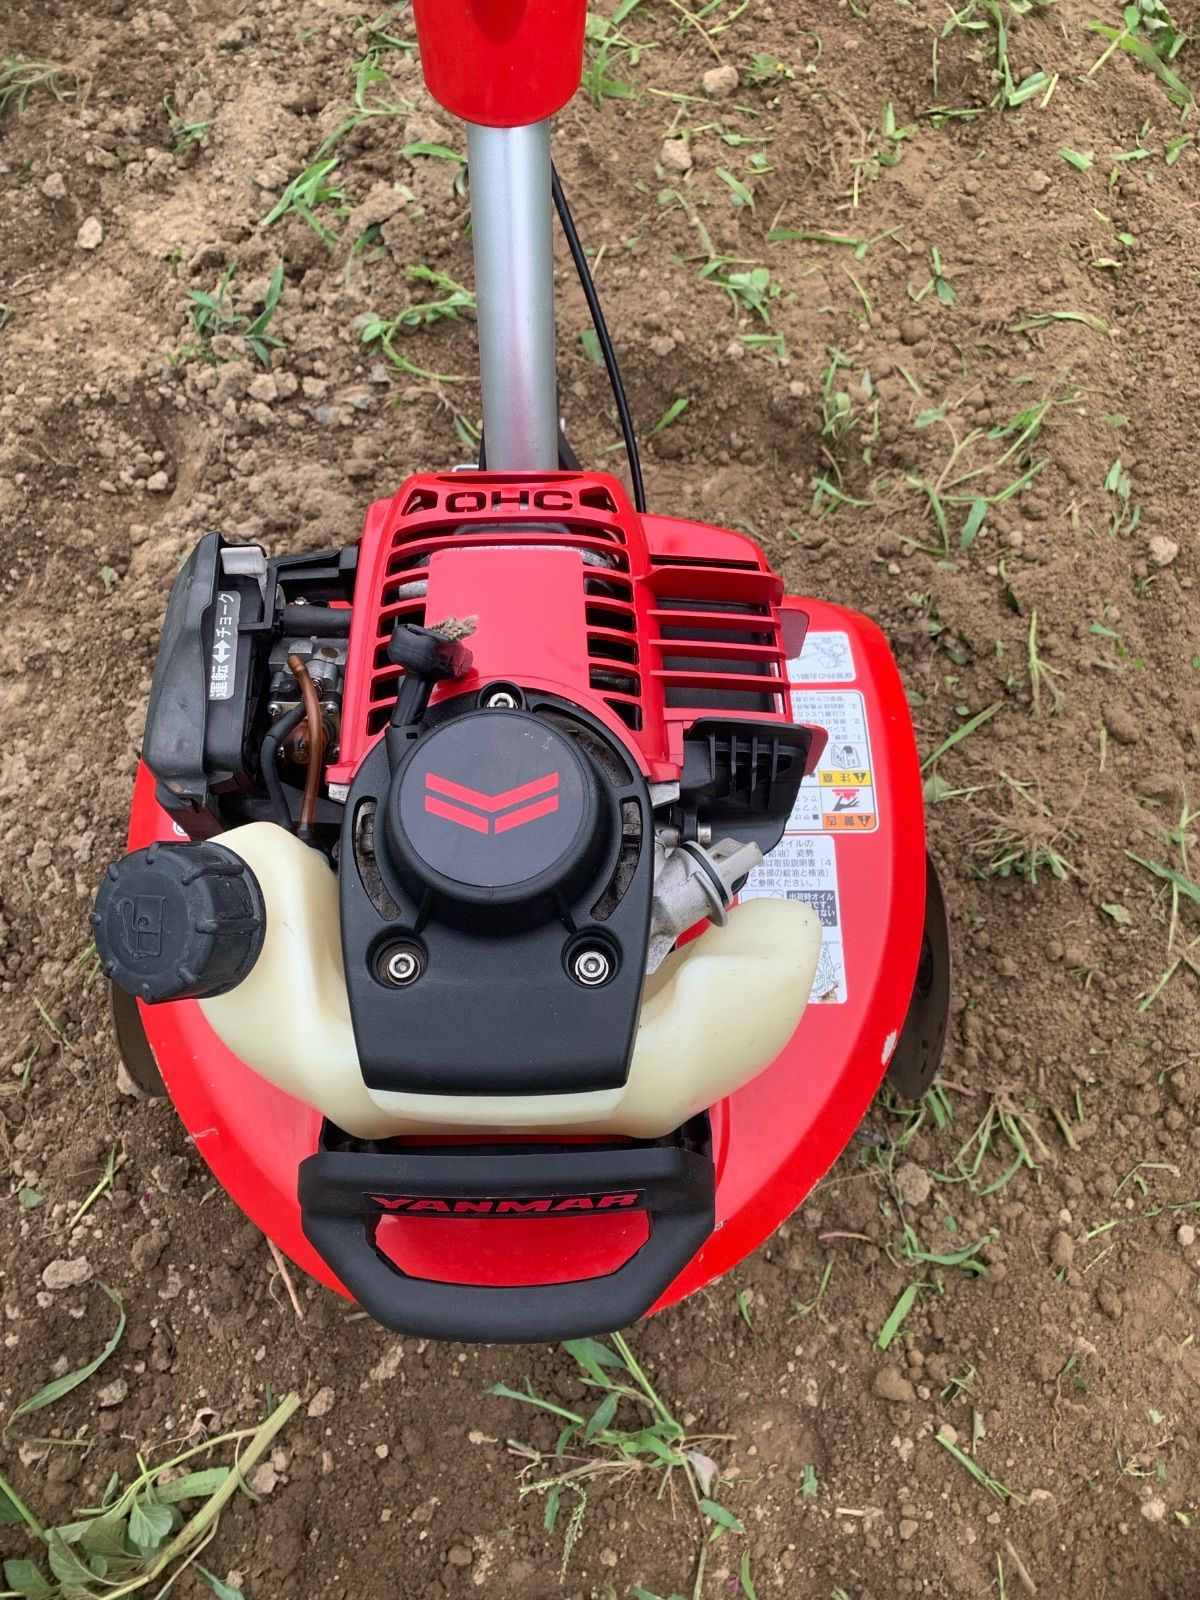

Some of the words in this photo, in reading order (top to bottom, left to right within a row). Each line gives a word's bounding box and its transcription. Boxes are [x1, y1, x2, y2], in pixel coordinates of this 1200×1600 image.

[445, 490, 573, 513] OHC
[215, 593, 235, 639] チョーク
[210, 664, 229, 698] 運転
[823, 773, 851, 783] 注意
[826, 816, 855, 827] 警告
[370, 1193, 639, 1212] YANMAR
